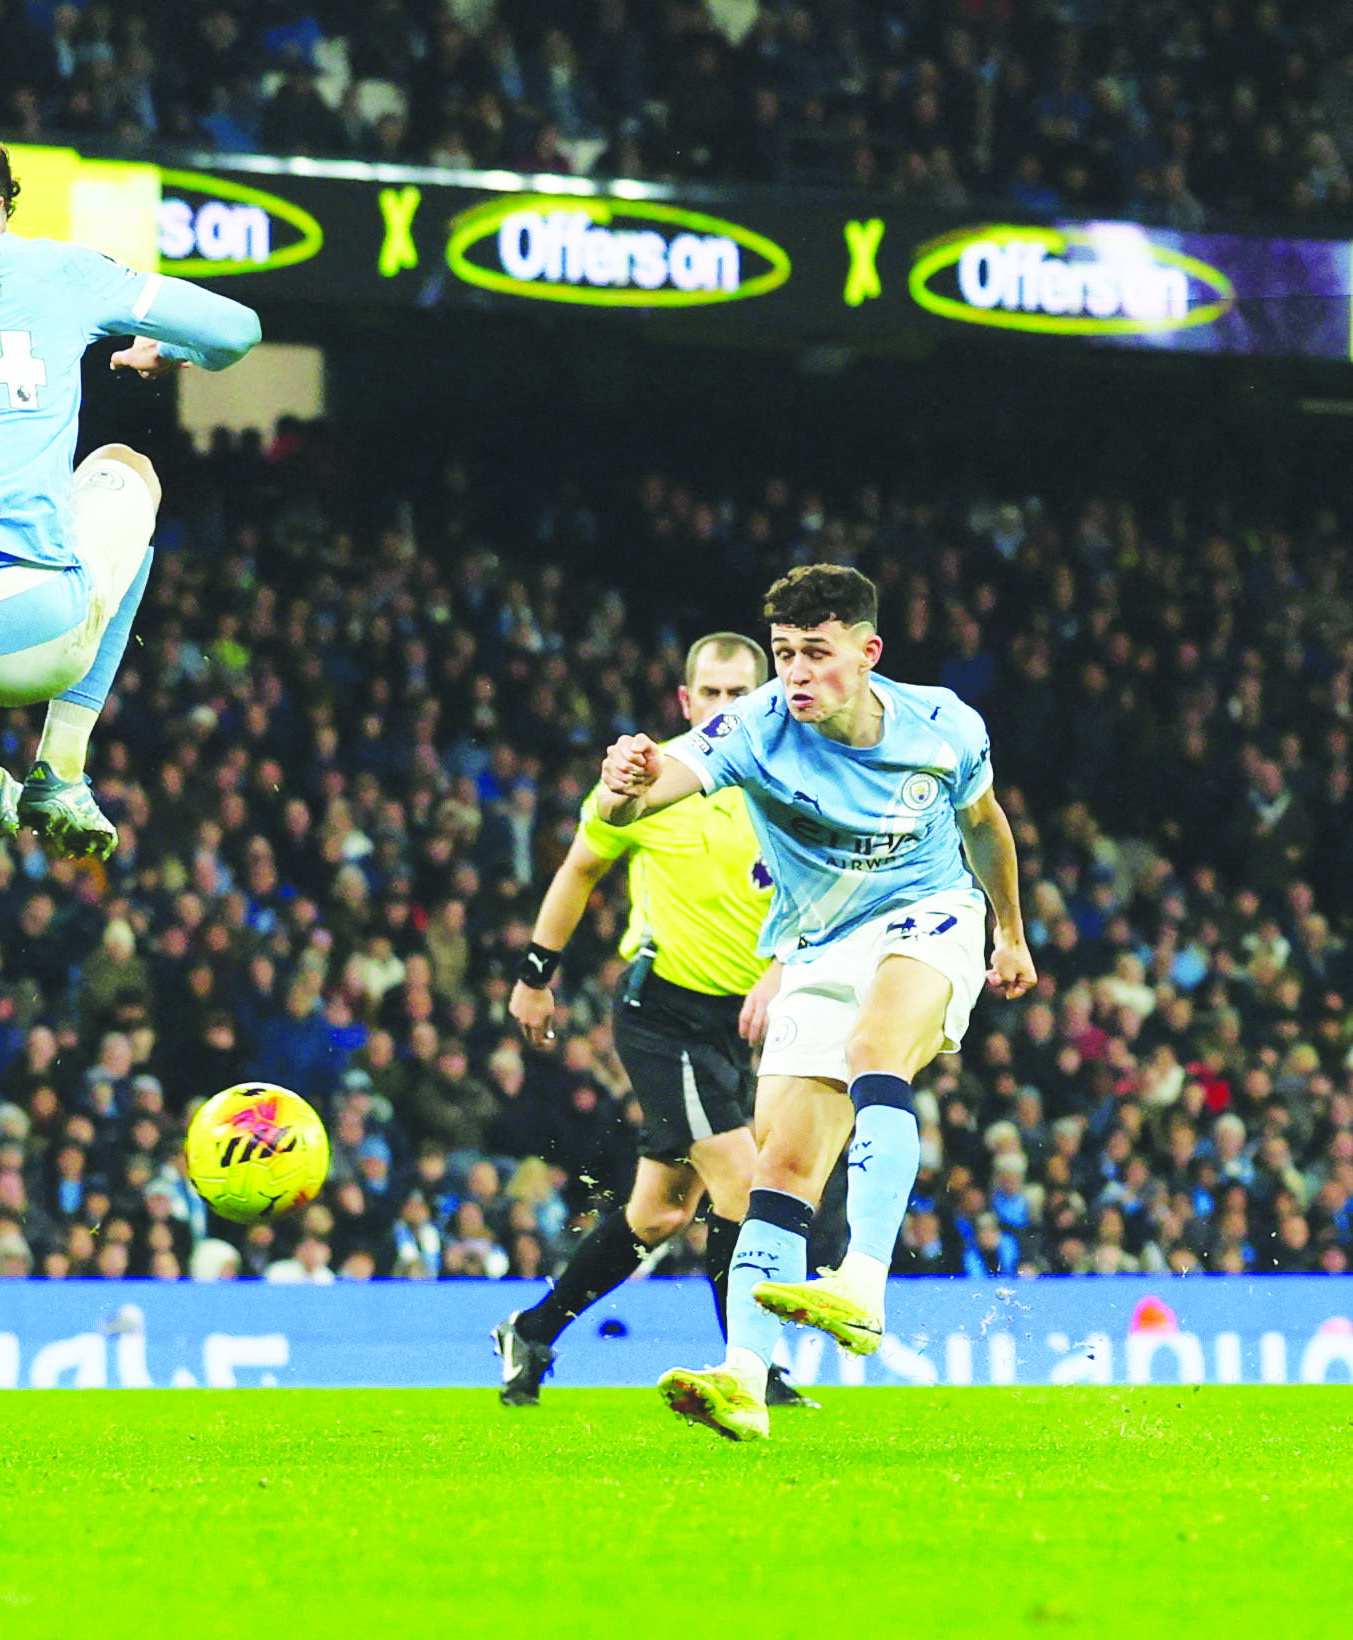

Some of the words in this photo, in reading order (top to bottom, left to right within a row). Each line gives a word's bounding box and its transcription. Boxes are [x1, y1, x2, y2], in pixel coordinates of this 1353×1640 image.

[498, 210, 667, 288] Offers
[669, 232, 740, 293] on
[826, 855, 896, 872] AIRW
